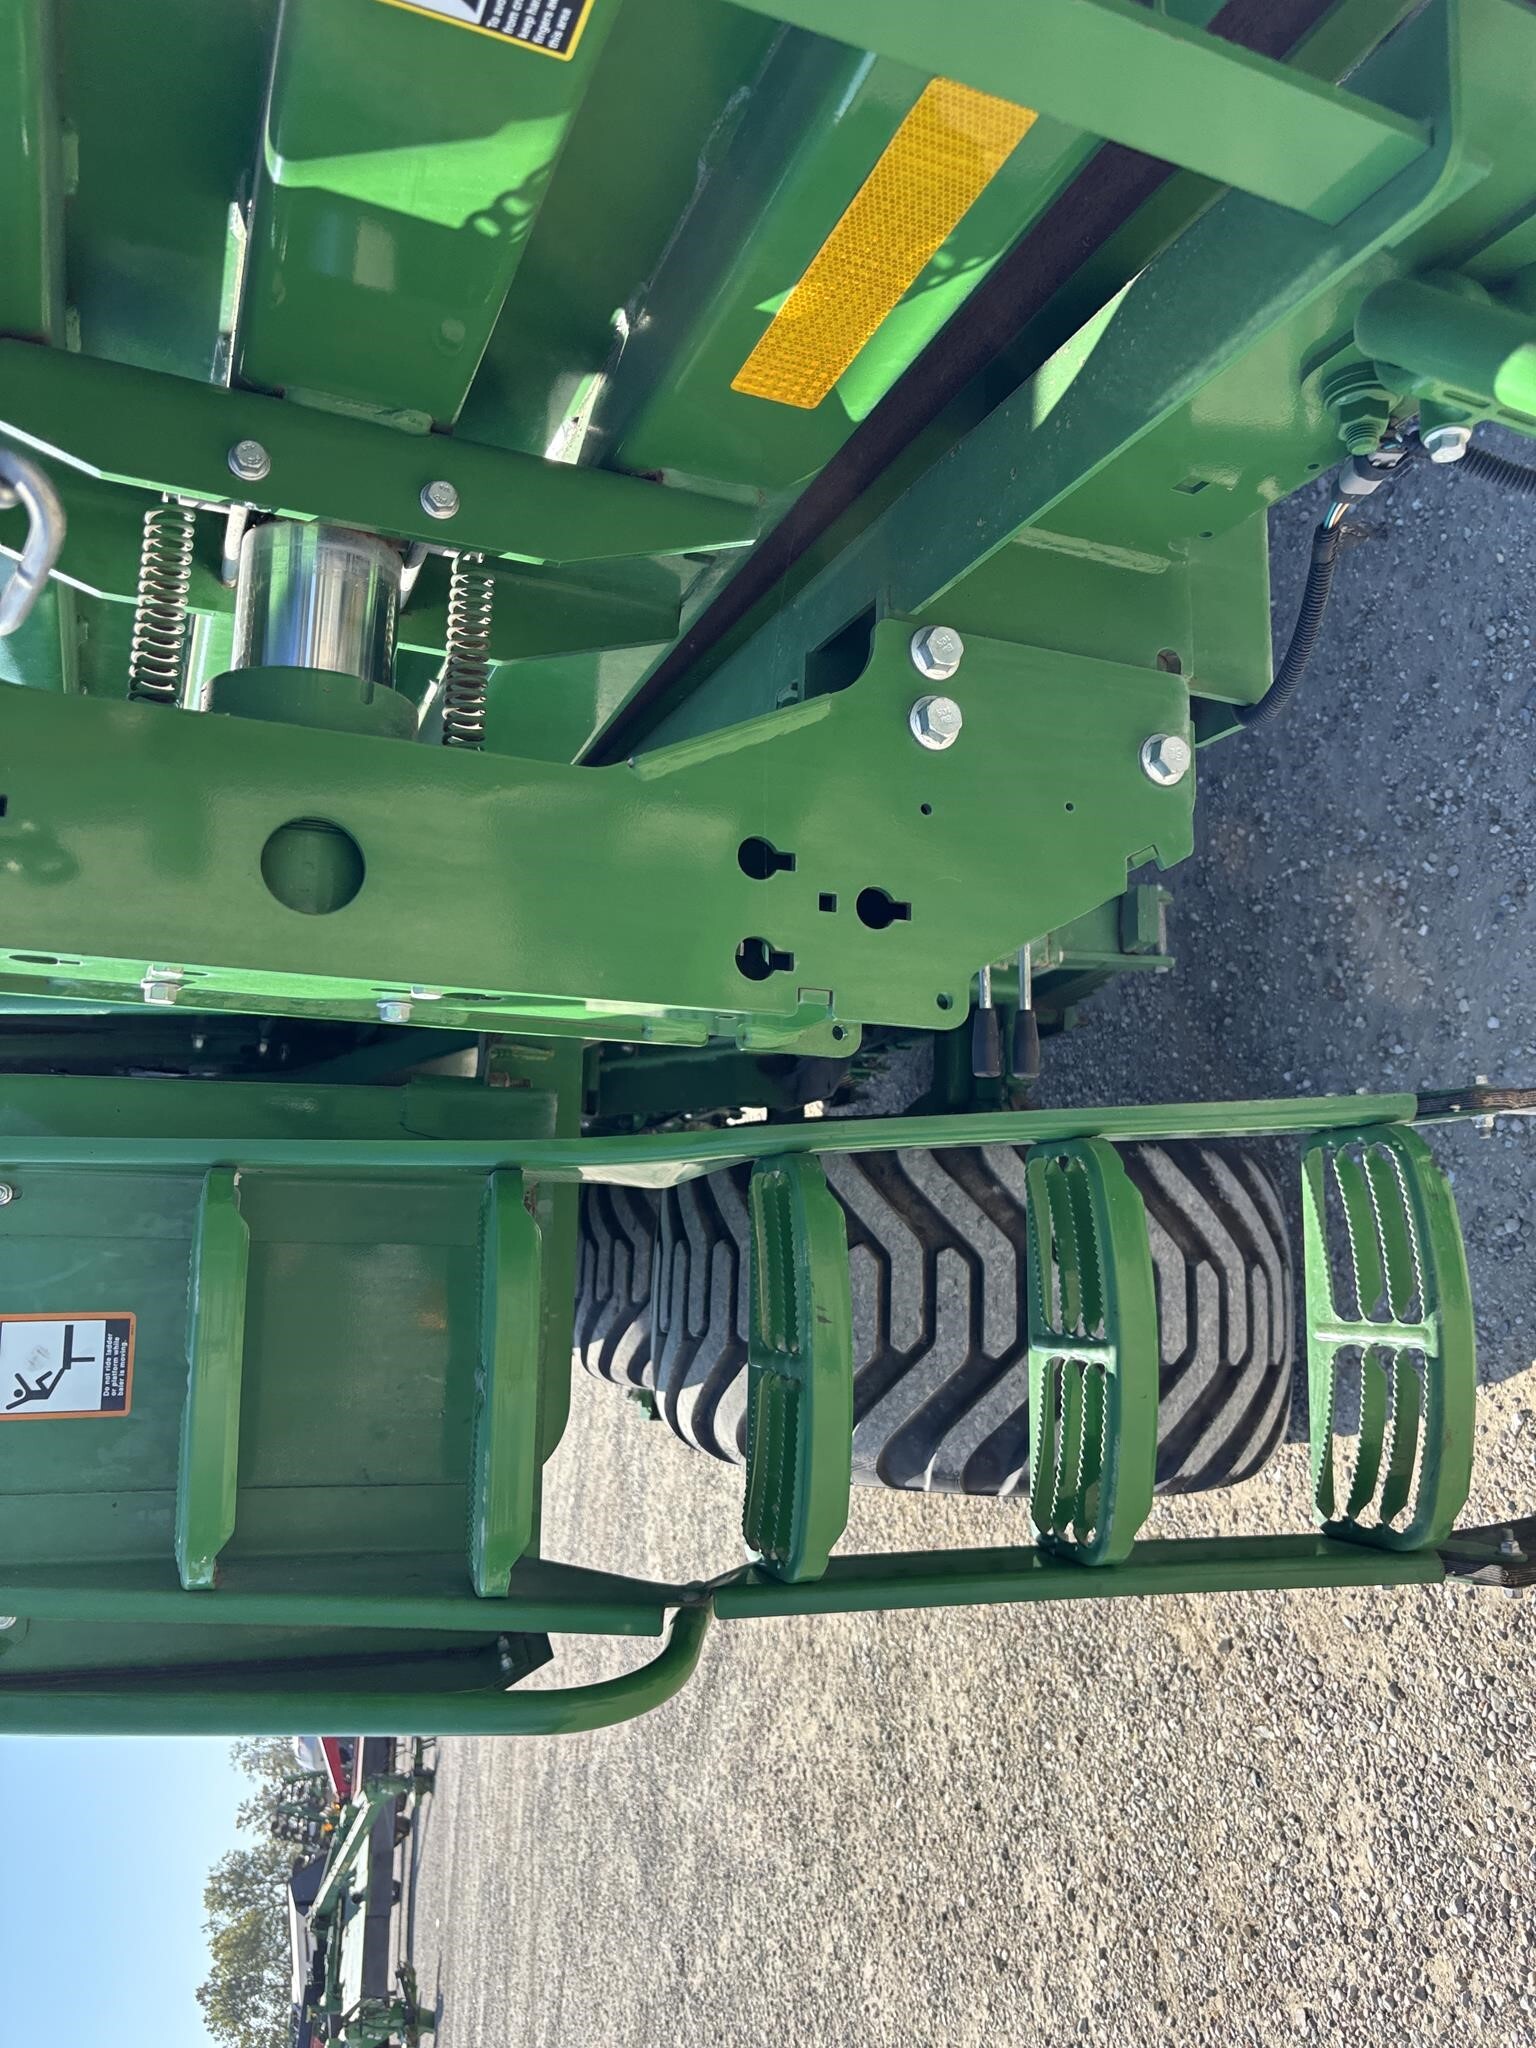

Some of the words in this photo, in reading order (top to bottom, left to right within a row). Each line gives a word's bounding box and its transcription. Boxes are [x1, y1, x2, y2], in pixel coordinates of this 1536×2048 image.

[486, 15, 501, 28] To
[502, 12, 520, 34] from
[517, 15, 537, 39] keep
[532, 10, 554, 44] fingers
[547, 30, 563, 49] this
[557, 8, 572, 30] area
[103, 1386, 110, 1397] Do
[111, 1388, 117, 1396] or
